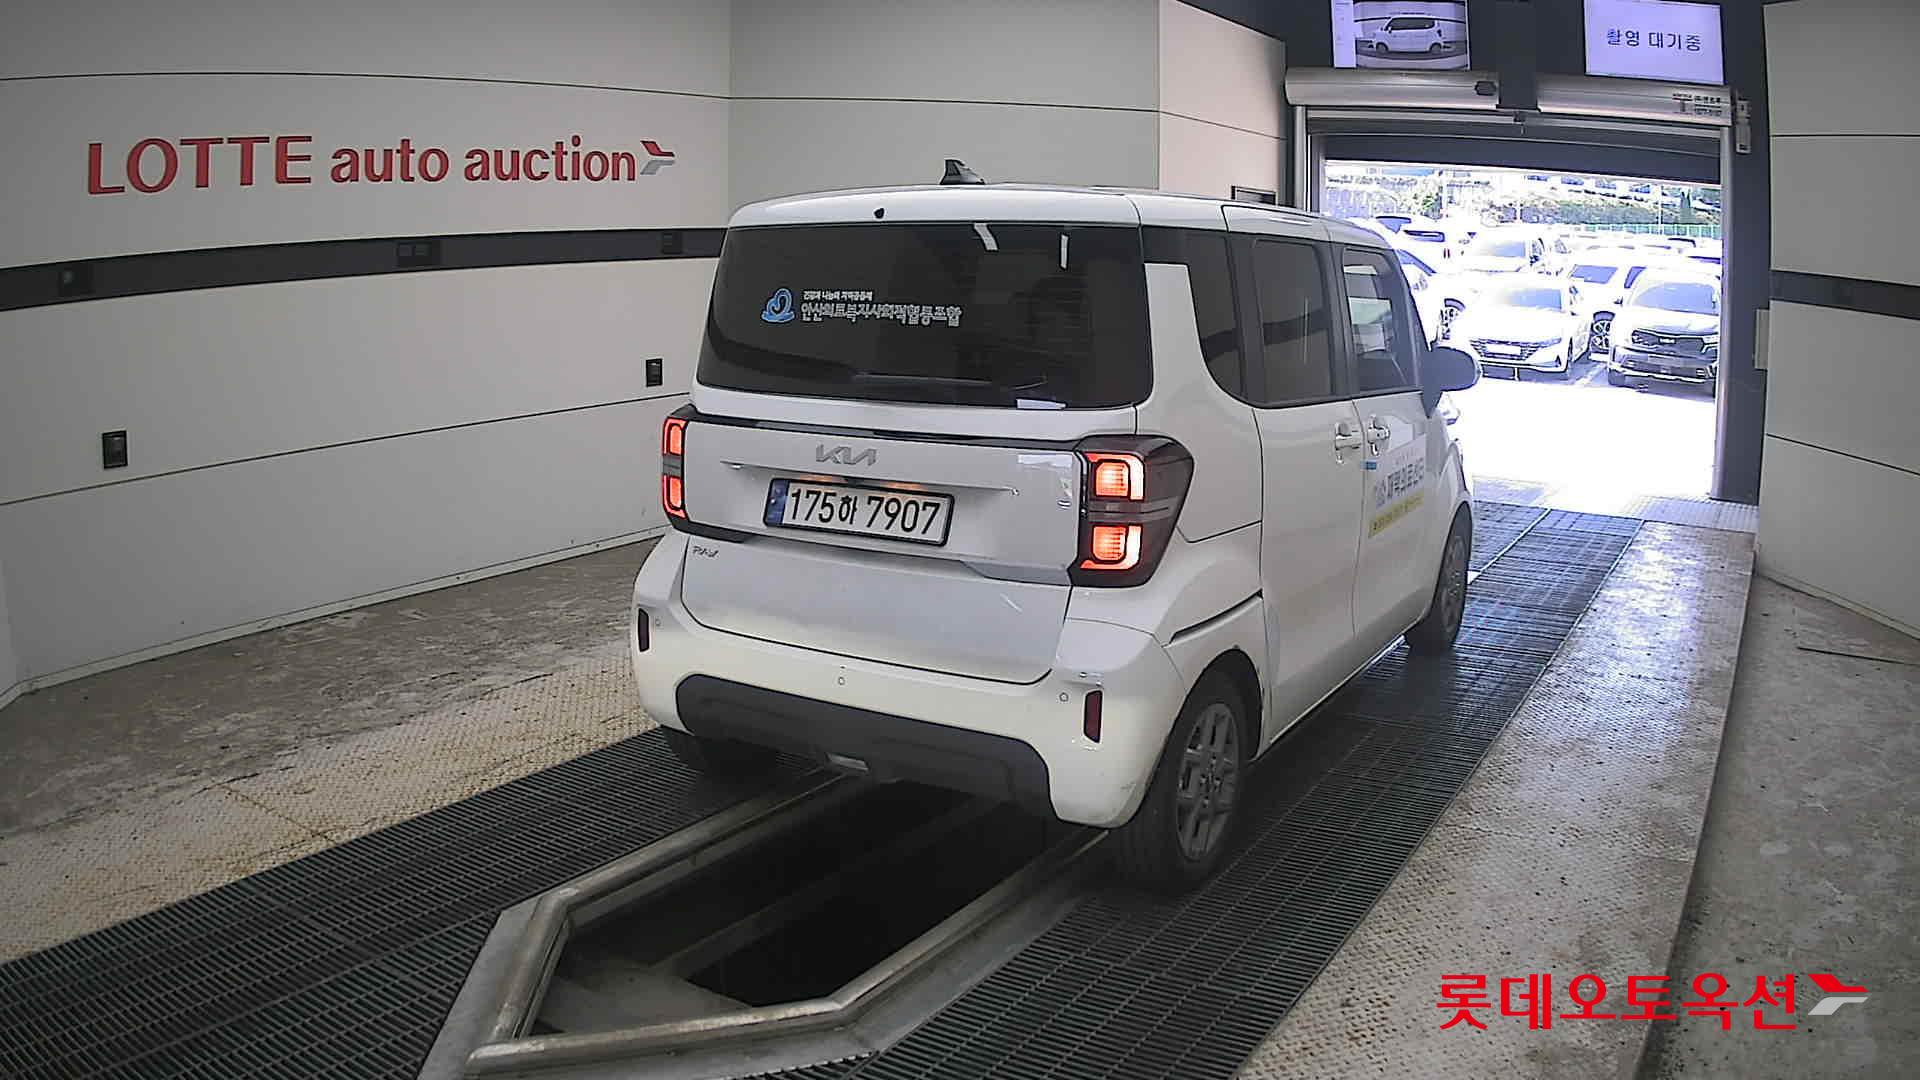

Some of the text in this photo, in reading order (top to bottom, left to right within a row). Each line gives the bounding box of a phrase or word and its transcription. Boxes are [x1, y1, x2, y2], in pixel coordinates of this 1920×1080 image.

[1607, 29, 1701, 52] 촬영 대기중
[88, 135, 636, 194] LOTTE auto auction
[816, 444, 877, 466] KIA
[791, 488, 941, 535] 175하 7907
